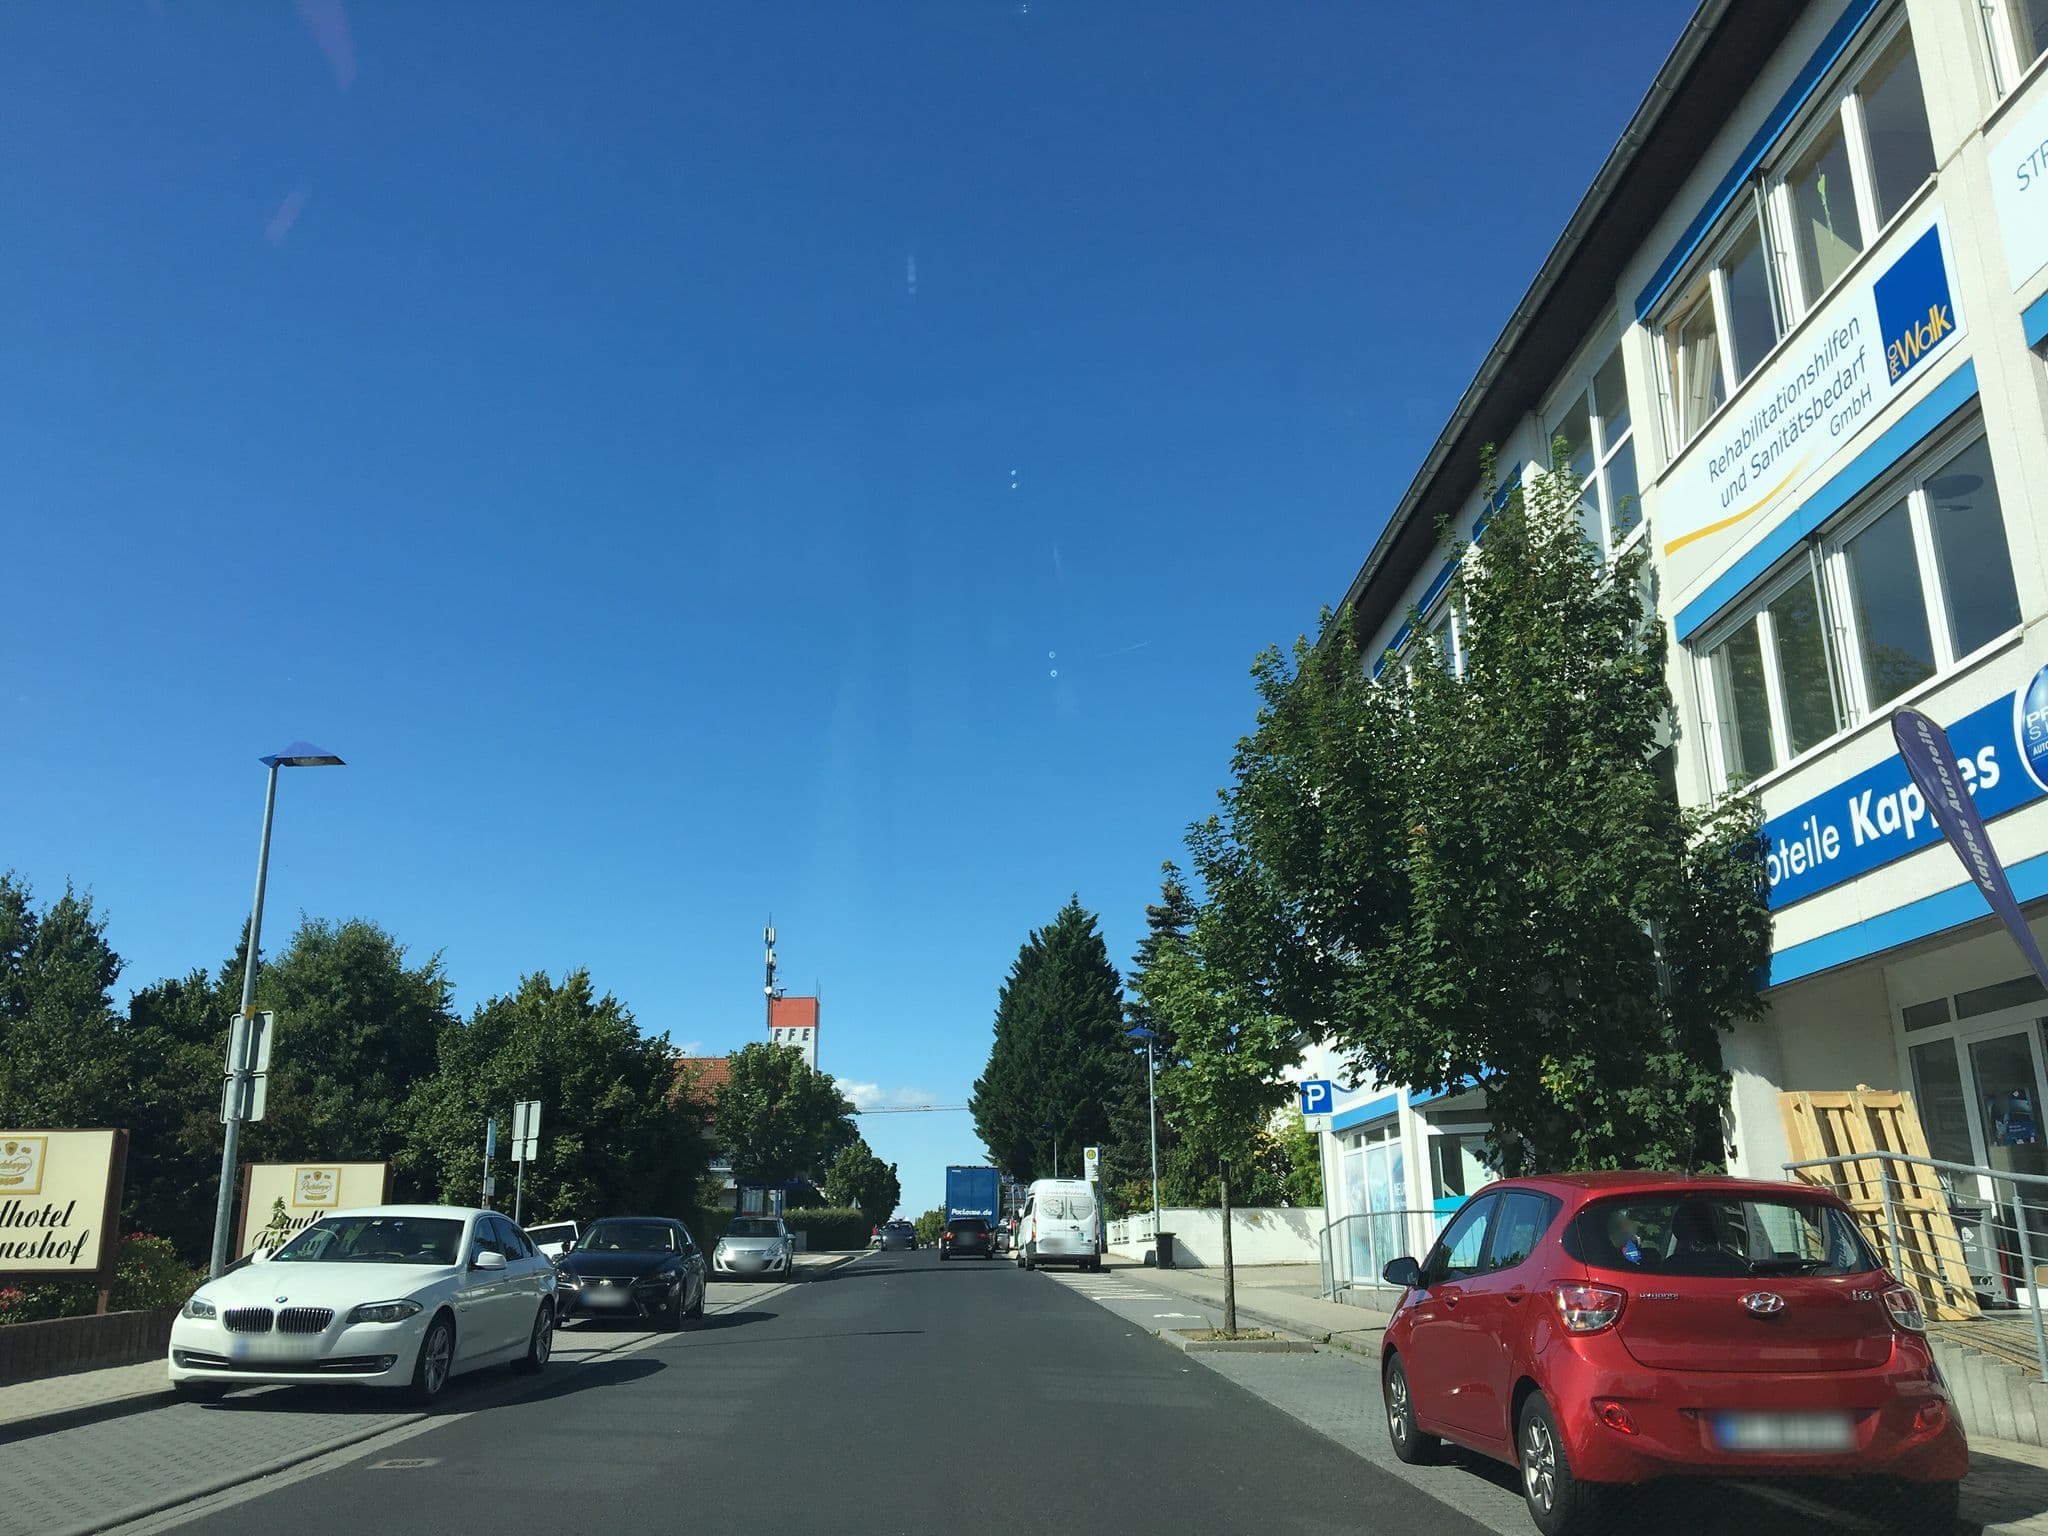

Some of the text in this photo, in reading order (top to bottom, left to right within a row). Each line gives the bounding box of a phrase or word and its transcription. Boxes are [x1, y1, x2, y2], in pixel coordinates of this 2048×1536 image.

[1888, 344, 1901, 379] PRO
[1895, 304, 1952, 368] Walk
[1709, 316, 1861, 483] Rehabilitationshilfen
[1720, 346, 1868, 508] und Sanitätsbedarf
[1830, 384, 1873, 438] GmbH
[1849, 745, 2000, 847] Kapes
[1916, 720, 1996, 892] Kappes Autoteile
[1307, 1084, 1325, 1110] P
